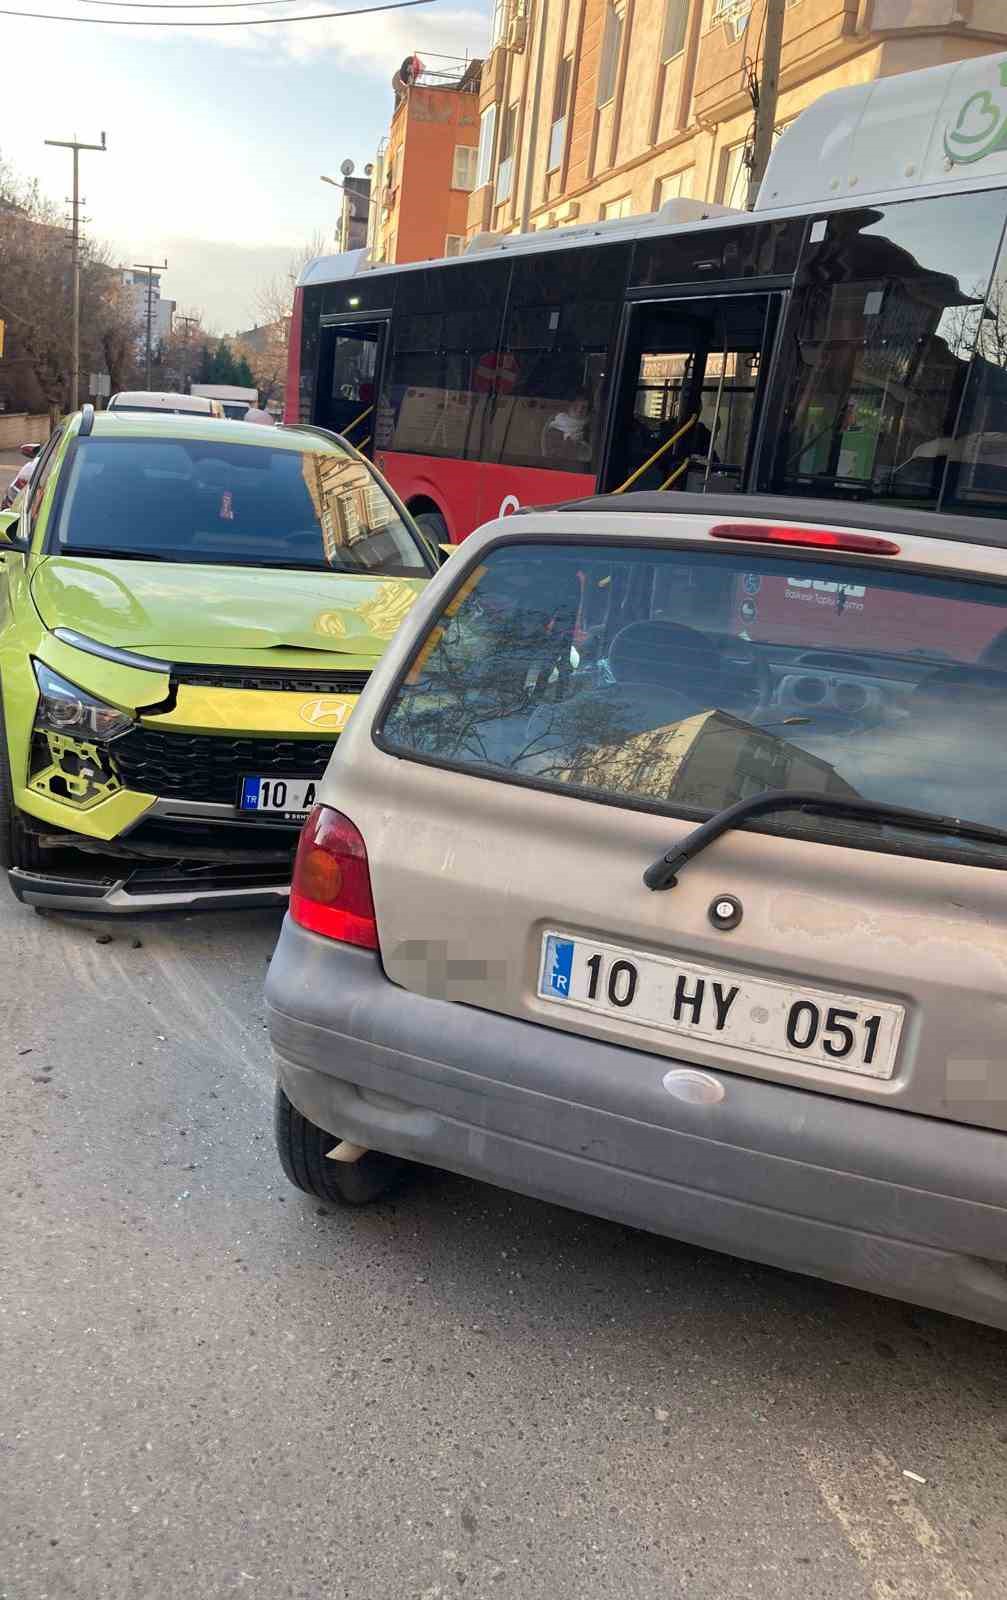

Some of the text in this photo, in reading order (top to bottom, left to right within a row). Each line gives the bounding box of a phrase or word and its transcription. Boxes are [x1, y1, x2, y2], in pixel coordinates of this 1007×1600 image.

[246, 795, 257, 803] TR
[261, 781, 287, 808] 10
[550, 954, 881, 1063] TR 10 HY 051
